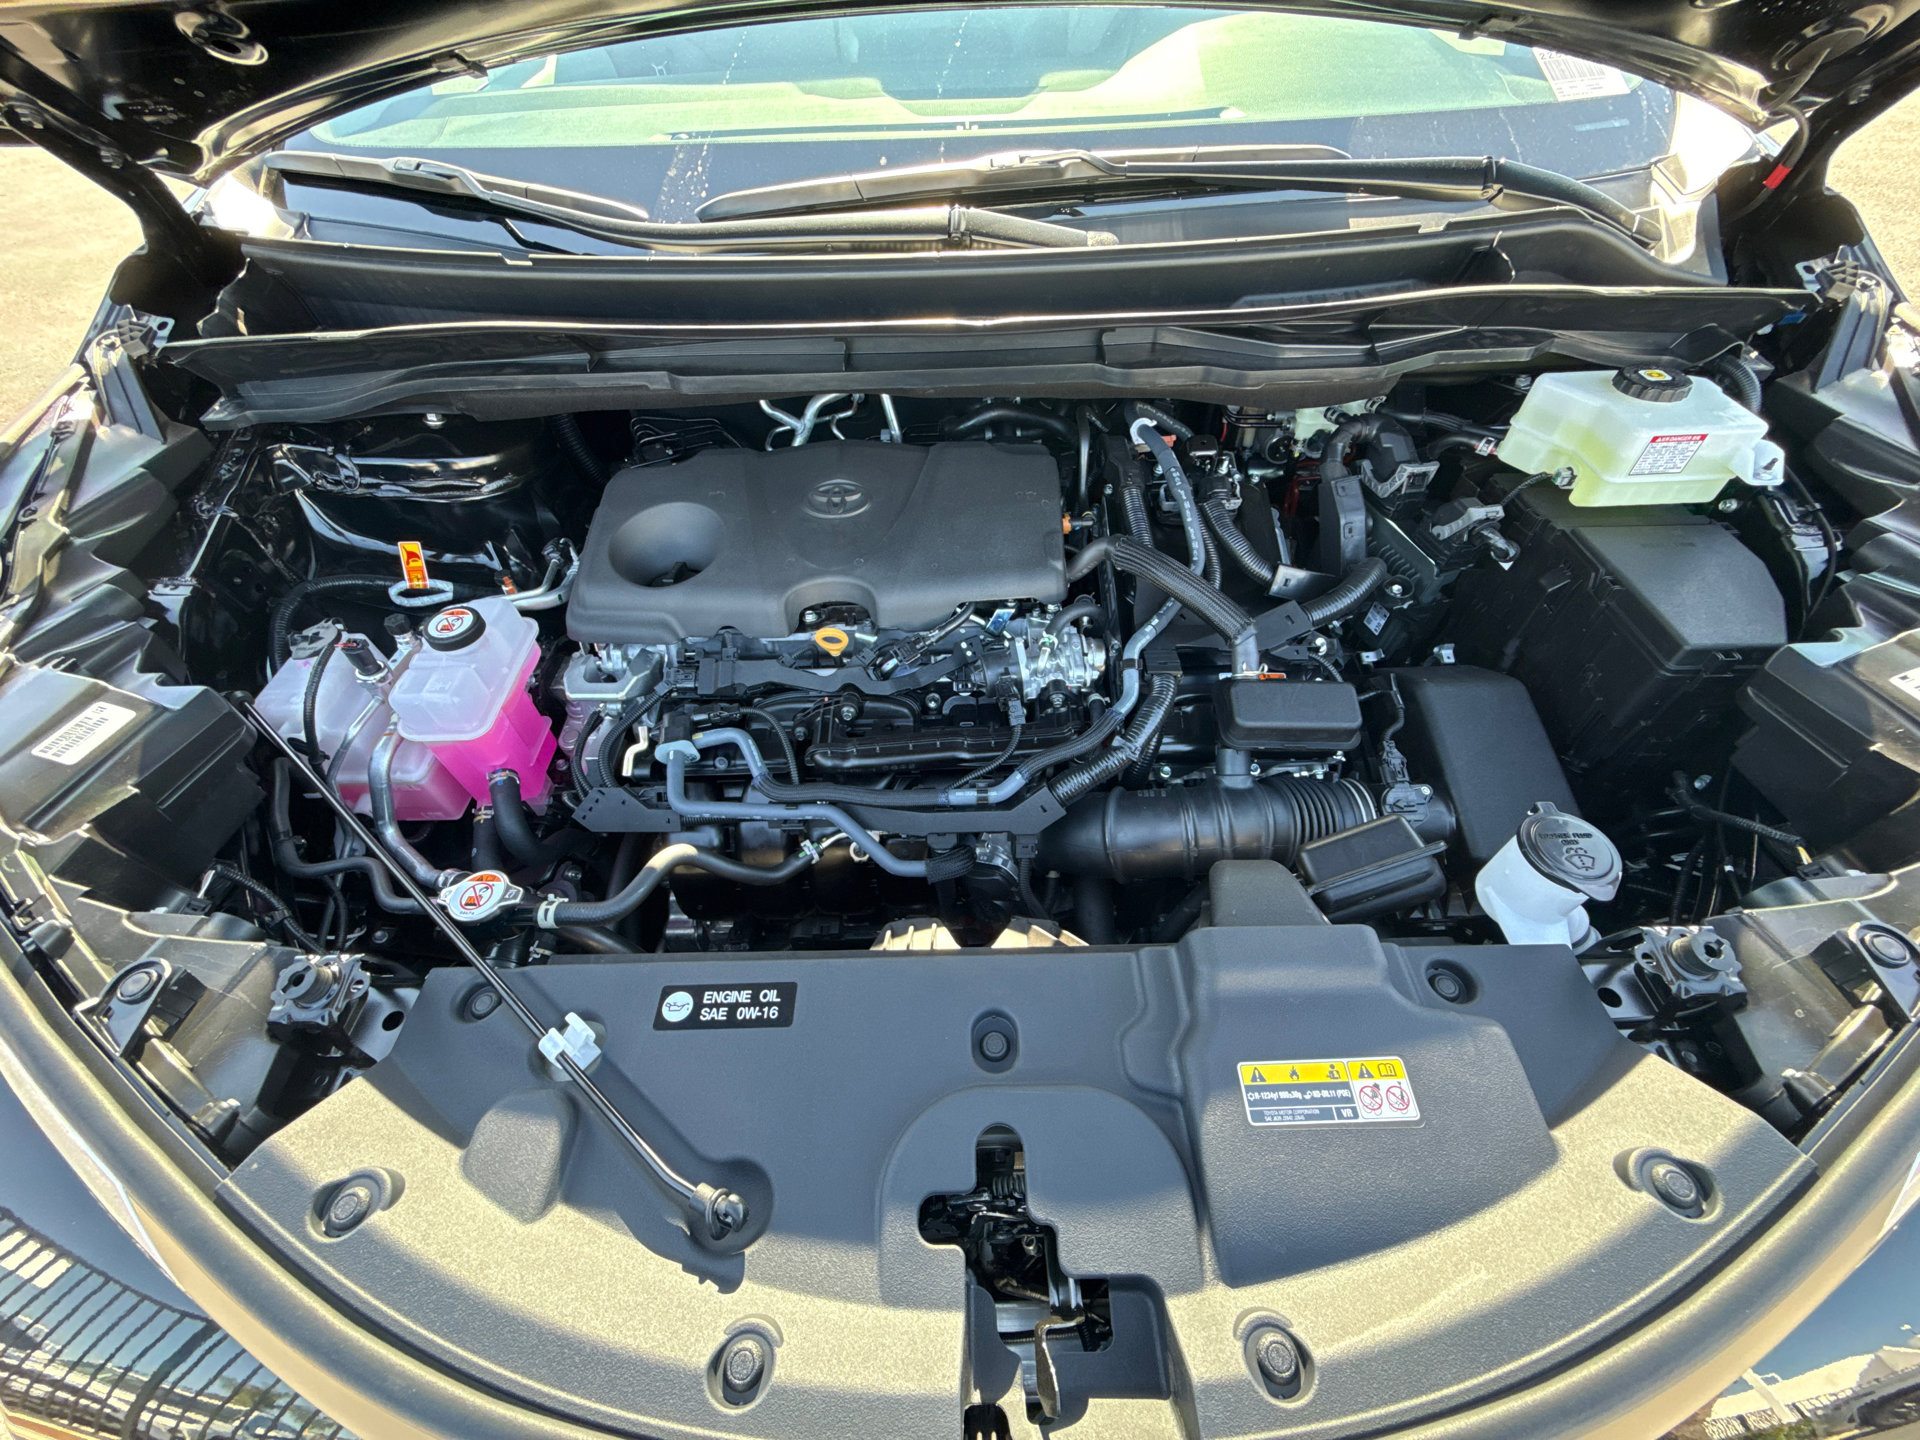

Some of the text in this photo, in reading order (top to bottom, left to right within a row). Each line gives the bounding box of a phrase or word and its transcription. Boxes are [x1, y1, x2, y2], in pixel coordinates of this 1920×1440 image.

[702, 989, 781, 1004] ENGINE OIL
[699, 1006, 779, 1021] SAE 0W-16
[1341, 1108, 1354, 1118] VR
